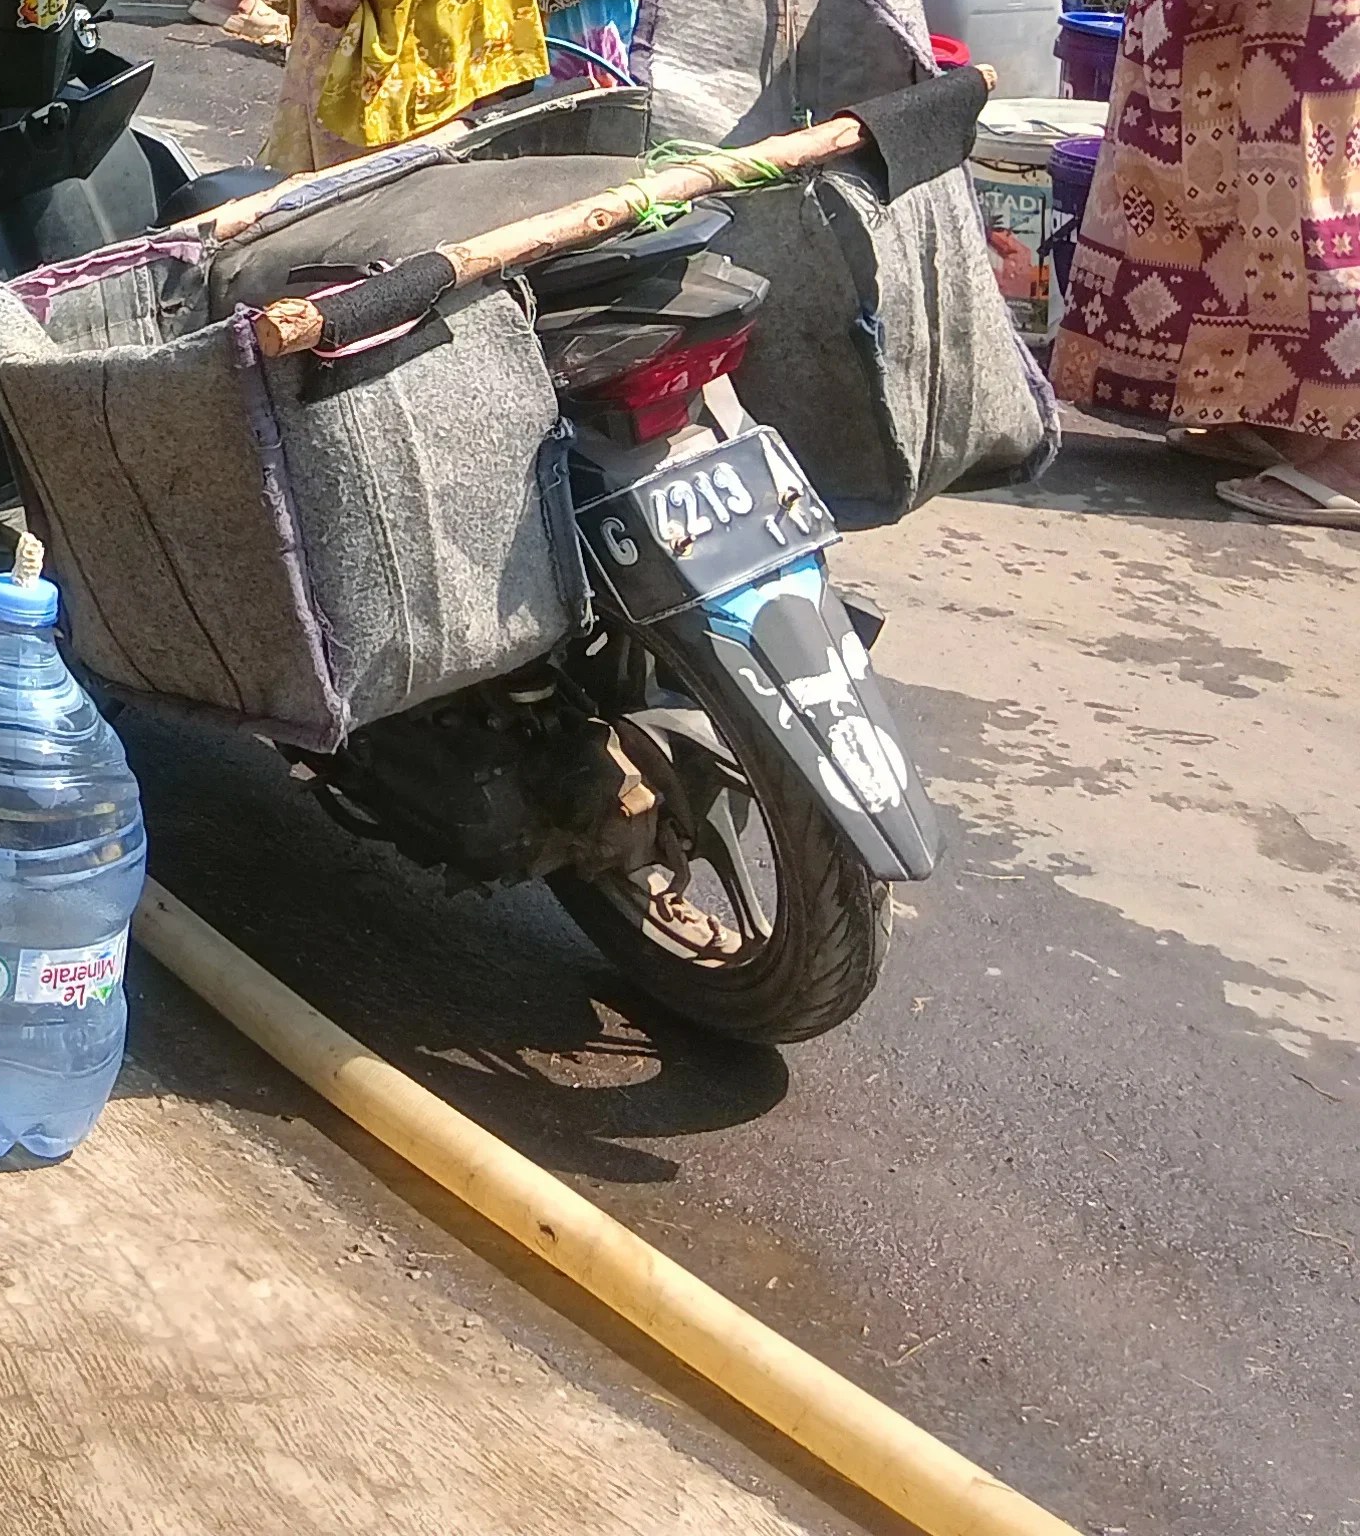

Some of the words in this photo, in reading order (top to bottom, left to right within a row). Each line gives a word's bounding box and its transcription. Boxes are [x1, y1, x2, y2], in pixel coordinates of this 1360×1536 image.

[601, 516, 639, 566] G
[40, 956, 116, 989] Minerale
[63, 984, 86, 1007] Le
